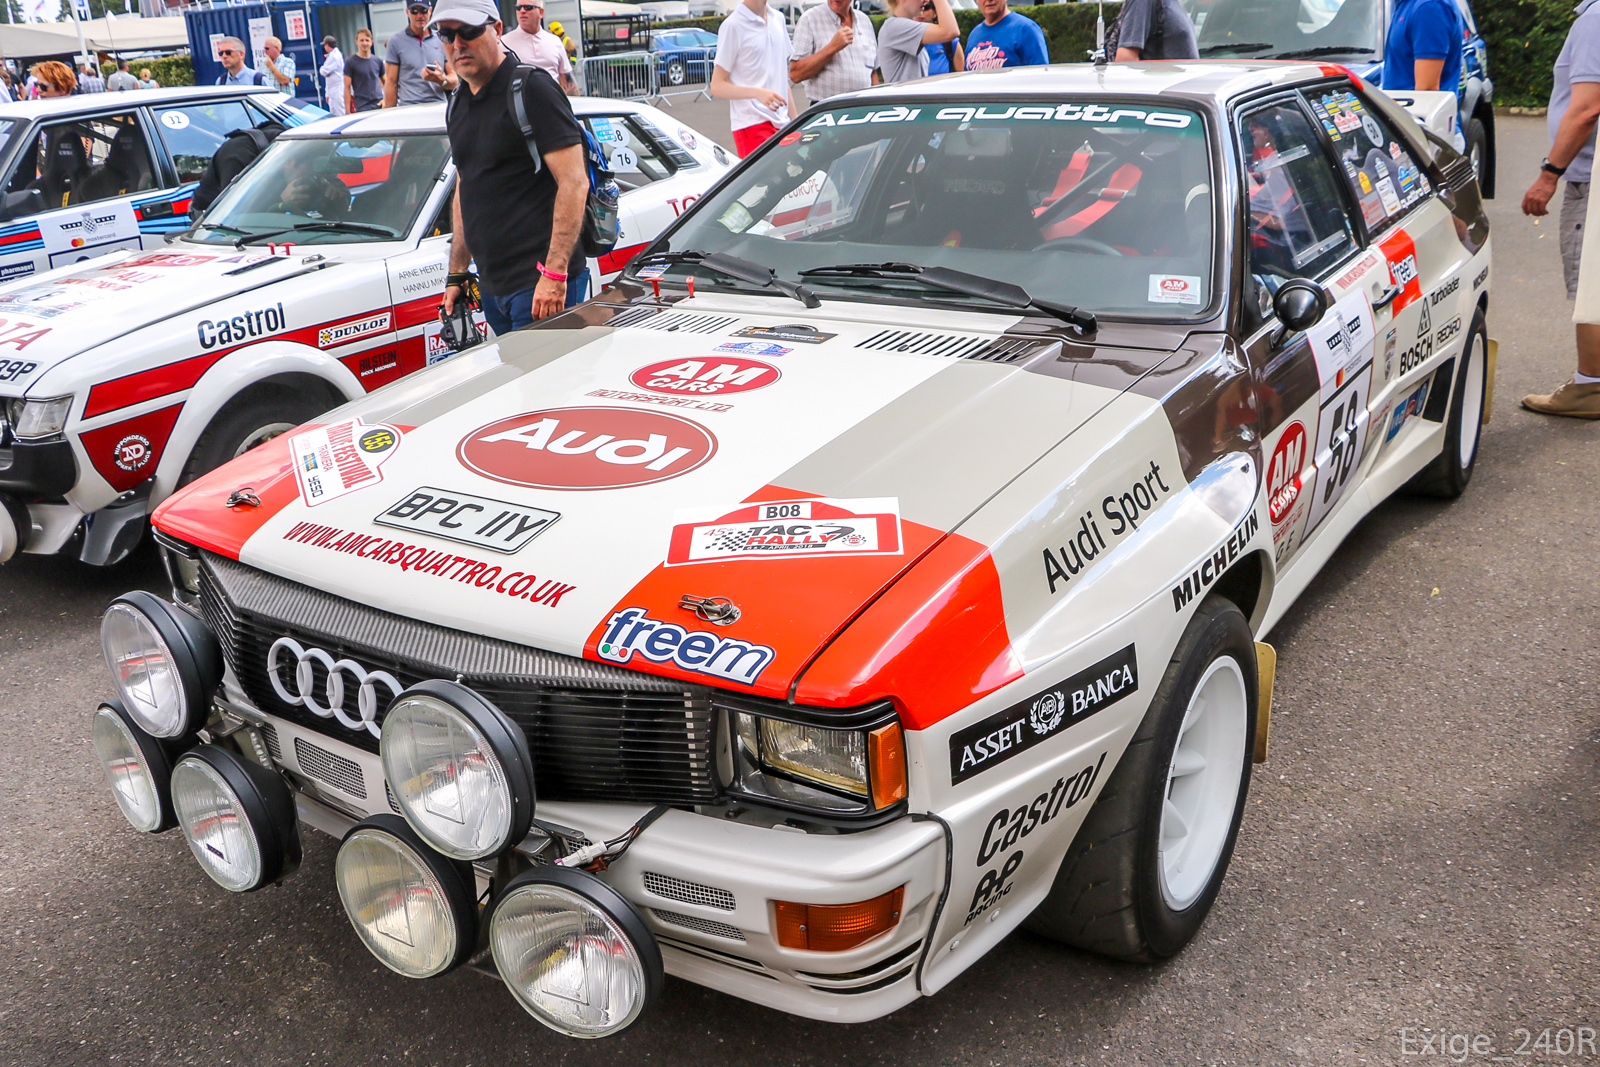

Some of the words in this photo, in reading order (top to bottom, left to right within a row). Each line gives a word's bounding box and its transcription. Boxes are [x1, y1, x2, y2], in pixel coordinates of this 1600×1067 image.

[168, 115, 182, 125] 32
[802, 104, 922, 131] Audi
[935, 103, 1192, 129] quattro
[617, 152, 631, 166] 76
[85, 232, 117, 243] mastercard
[0, 263, 34, 276] pharmagel
[398, 269, 420, 281] ARNE
[419, 262, 445, 275] HERTZ
[1391, 254, 1418, 294] freem
[402, 280, 431, 294] HANNU
[1163, 280, 1185, 288] AM
[197, 302, 286, 349] Castrol
[334, 317, 388, 339] DUNLOP
[1437, 317, 1461, 344] RECARO
[359, 350, 397, 372] BILSTEIN
[429, 349, 440, 358] SAT
[1400, 333, 1433, 377] BOSCH
[360, 367, 374, 377] SHOCK
[374, 361, 397, 374] ABSORBERS
[648, 359, 770, 386] AM
[645, 377, 725, 393] CARS
[584, 388, 698, 410] MOTORSPORT
[114, 434, 150, 455] NIPPONDENSO
[362, 431, 393, 450] 155
[477, 417, 693, 472] Audi
[1323, 389, 1358, 505] 58
[115, 459, 133, 471] SPARK
[137, 450, 152, 468] PLUGS
[332, 443, 376, 489] FESTIVAL
[1268, 430, 1303, 501] AM
[308, 475, 324, 498] YESO
[1270, 479, 1298, 518] CARS
[387, 493, 484, 529] BPC
[475, 511, 549, 542] 11Y
[765, 504, 801, 519] B08
[749, 525, 812, 536] TAC
[1042, 510, 1108, 594] Audi
[1102, 460, 1169, 535] Sport
[745, 534, 838, 545] RALLY
[282, 520, 577, 608] WWW.AMCARSQUATTRO.CO.UK
[1171, 509, 1259, 613] MICHELIN
[603, 609, 769, 681] freem
[960, 718, 1026, 772] ASSET
[1071, 664, 1134, 716] BANCA
[976, 751, 1108, 867] Castrol
[968, 850, 1024, 913] AP
